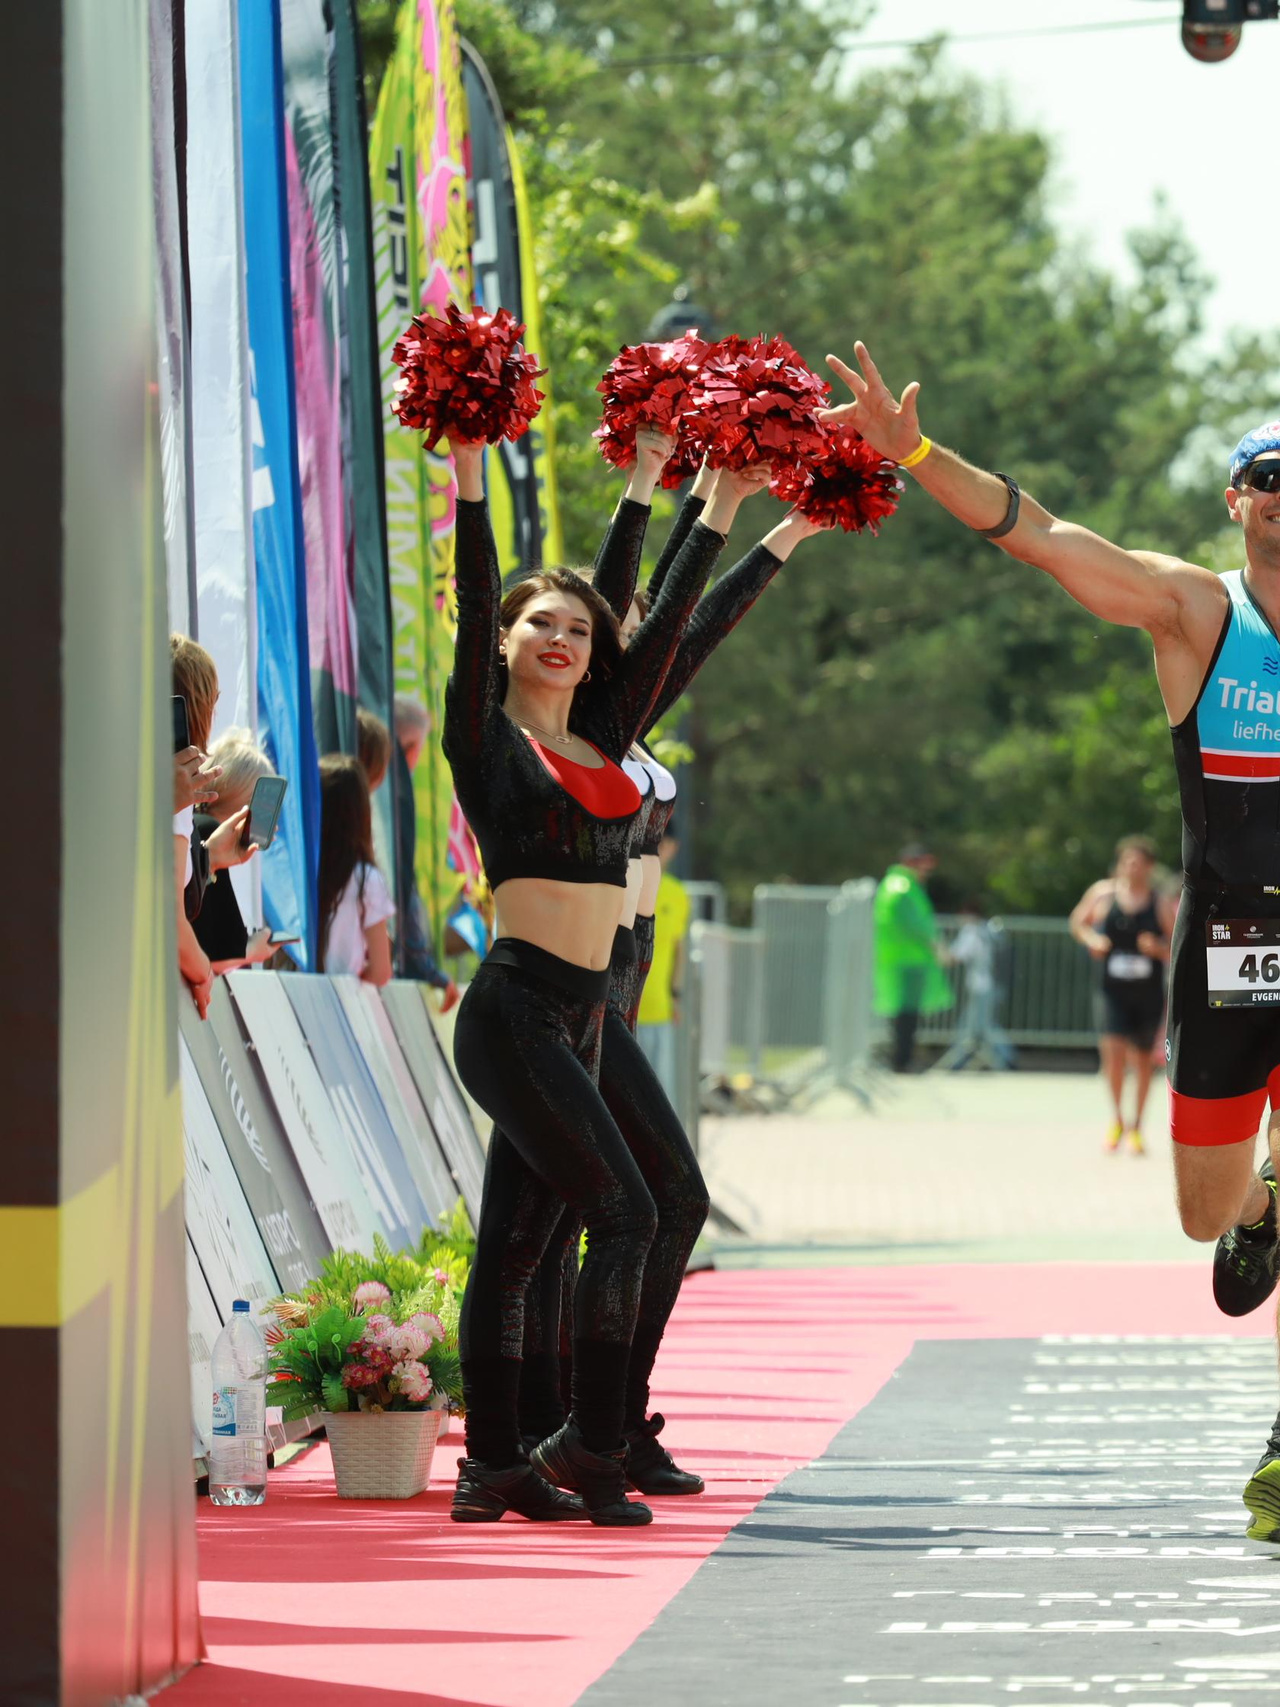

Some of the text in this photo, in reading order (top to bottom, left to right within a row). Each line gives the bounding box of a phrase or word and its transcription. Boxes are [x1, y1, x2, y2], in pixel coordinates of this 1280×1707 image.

[1212, 931, 1231, 940] STAR
[918, 1546, 1245, 1556] IRON
[886, 1617, 1243, 1631] IRON
